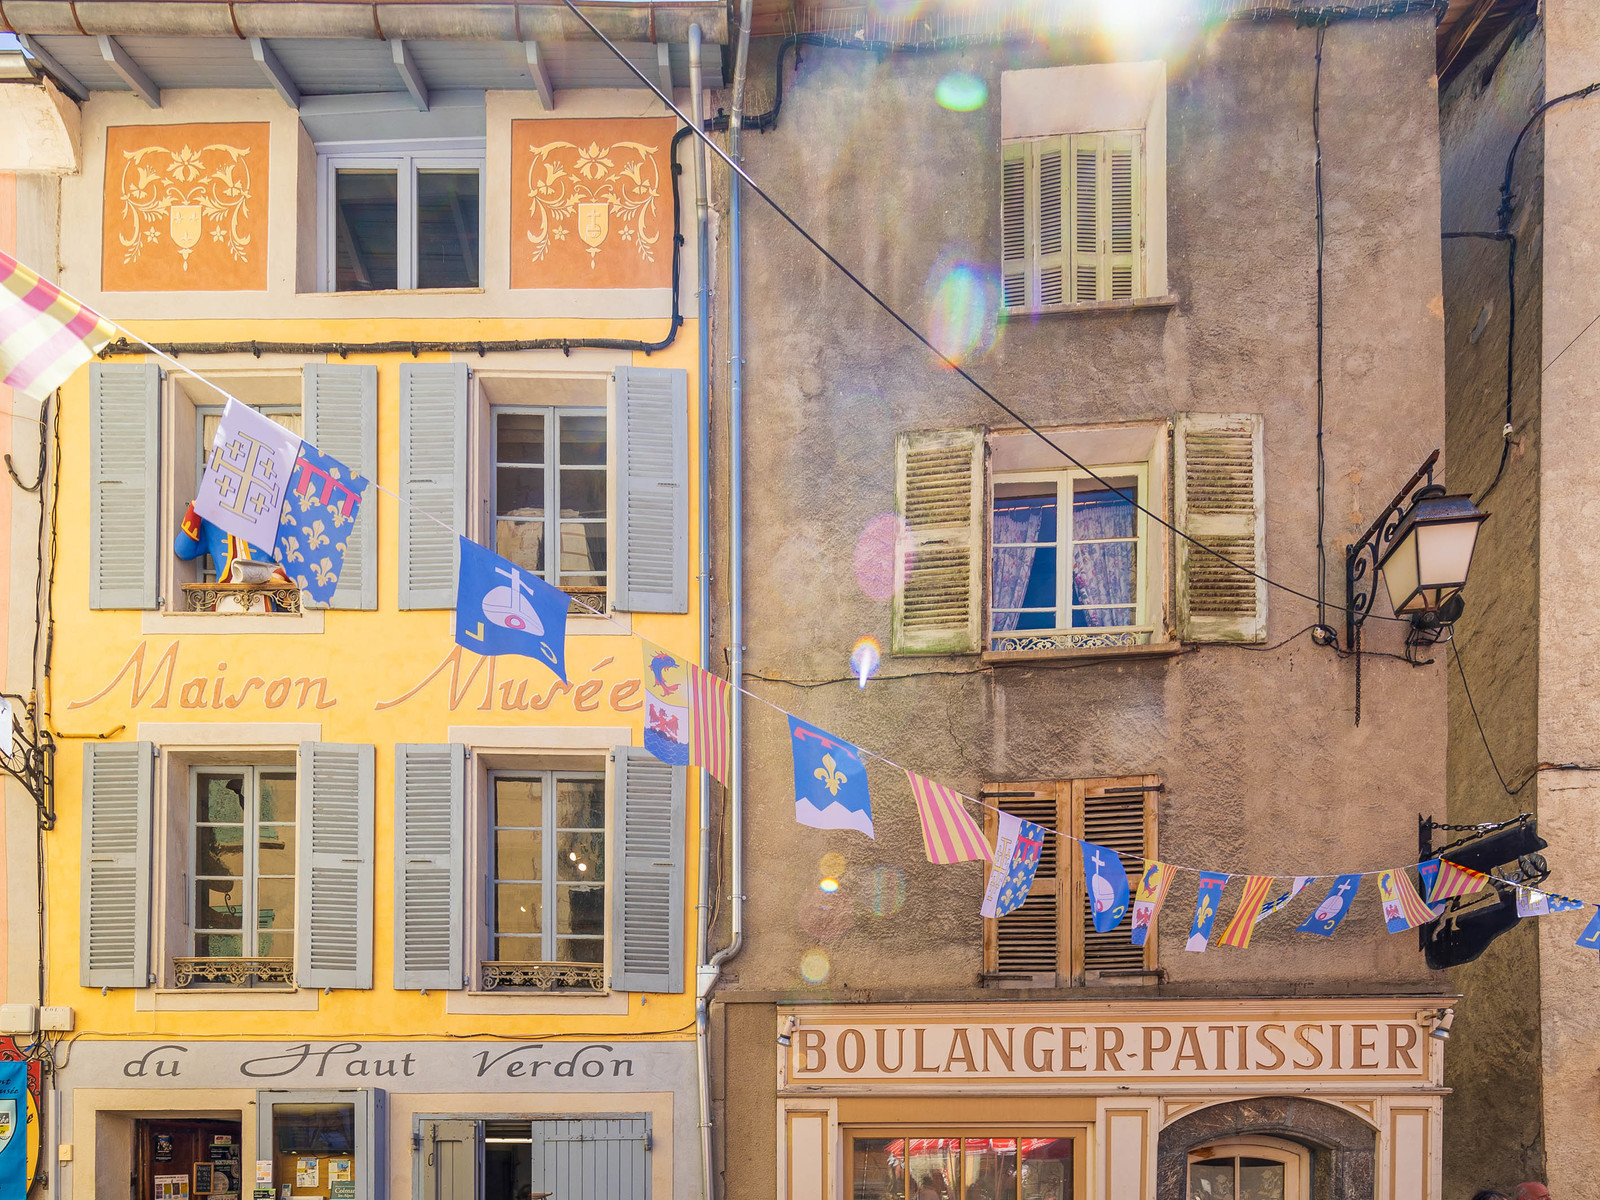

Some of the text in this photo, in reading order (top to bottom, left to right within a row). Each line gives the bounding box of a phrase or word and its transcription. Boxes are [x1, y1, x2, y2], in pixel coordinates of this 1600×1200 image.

[67, 639, 644, 712] Maison Musée
[123, 1042, 635, 1078] du Haut Verdon
